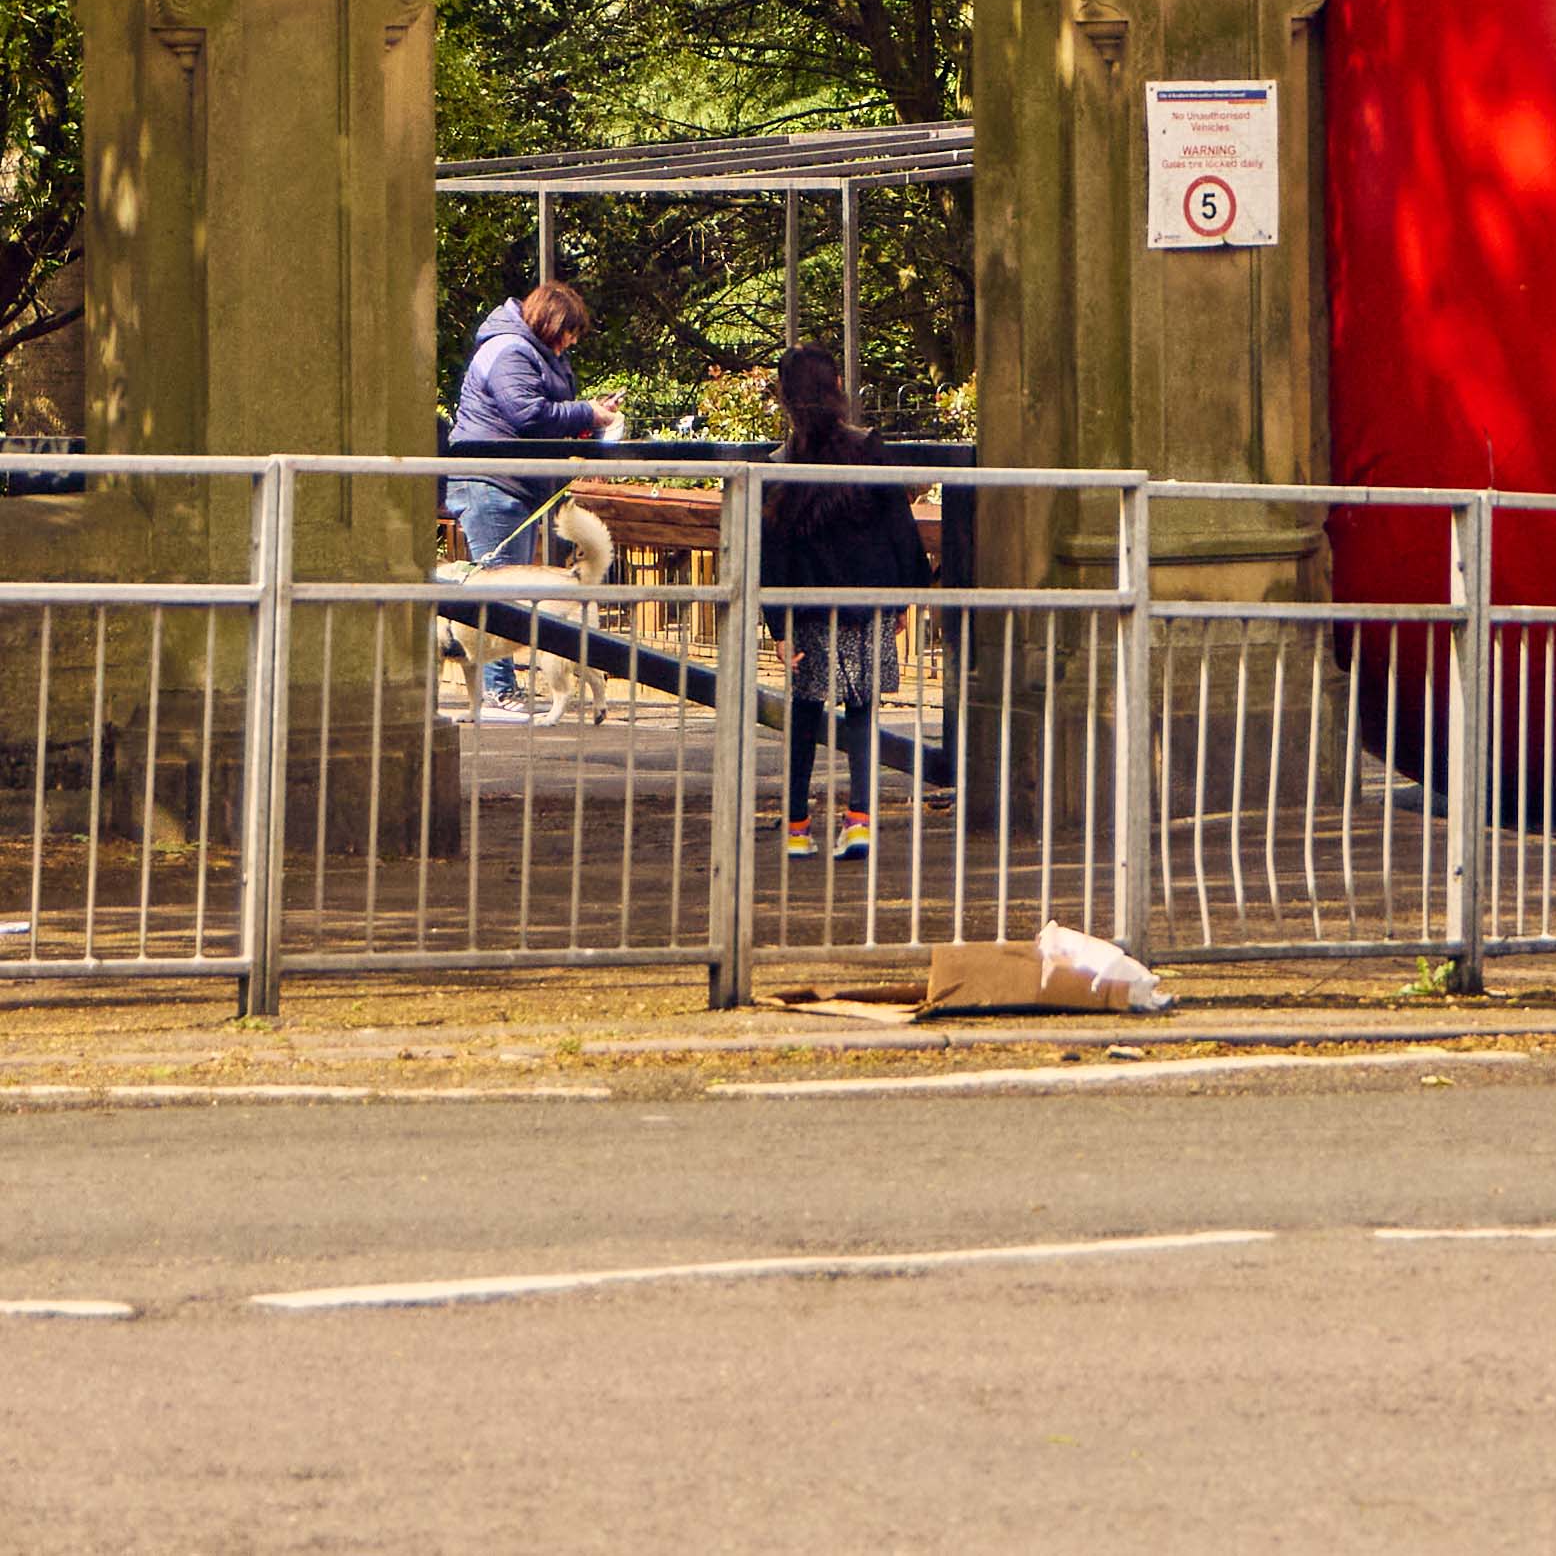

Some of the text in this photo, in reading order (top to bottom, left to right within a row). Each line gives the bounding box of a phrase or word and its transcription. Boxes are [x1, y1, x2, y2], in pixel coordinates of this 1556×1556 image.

[1172, 111, 1250, 120] No Unauthorised
[1192, 122, 1230, 132] Vehicles
[1183, 145, 1237, 155] WARNING
[1205, 159, 1237, 168] locked
[1240, 159, 1264, 169] daily
[1201, 192, 1217, 219] 5
